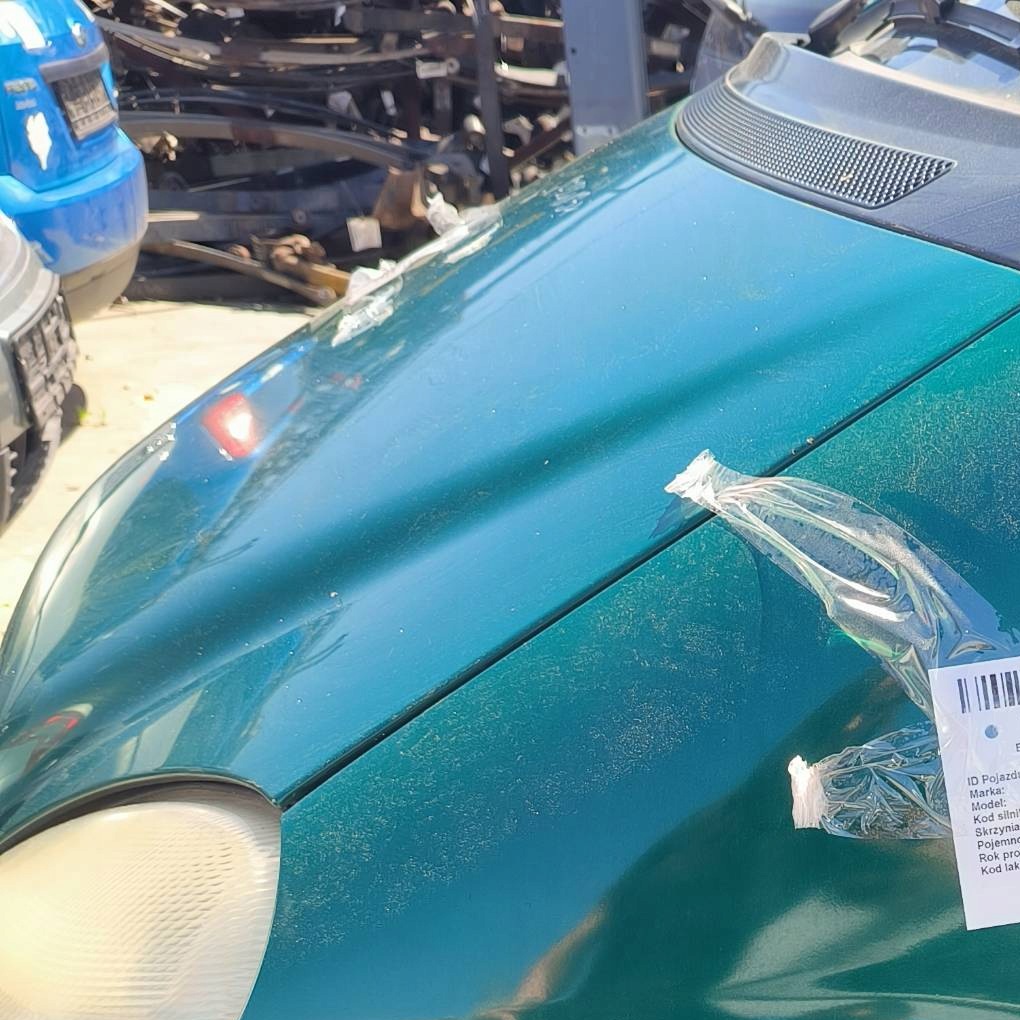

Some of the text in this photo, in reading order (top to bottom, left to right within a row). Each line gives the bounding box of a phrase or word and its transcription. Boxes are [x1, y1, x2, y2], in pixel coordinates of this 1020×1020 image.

[967, 776, 979, 786] ID
[969, 787, 1005, 799] Marka:
[971, 798, 1007, 811] Model:
[973, 812, 995, 824] Kod
[975, 822, 1020, 837] Skrzynia
[979, 851, 1000, 863] Rok
[981, 863, 1002, 876] Kod
